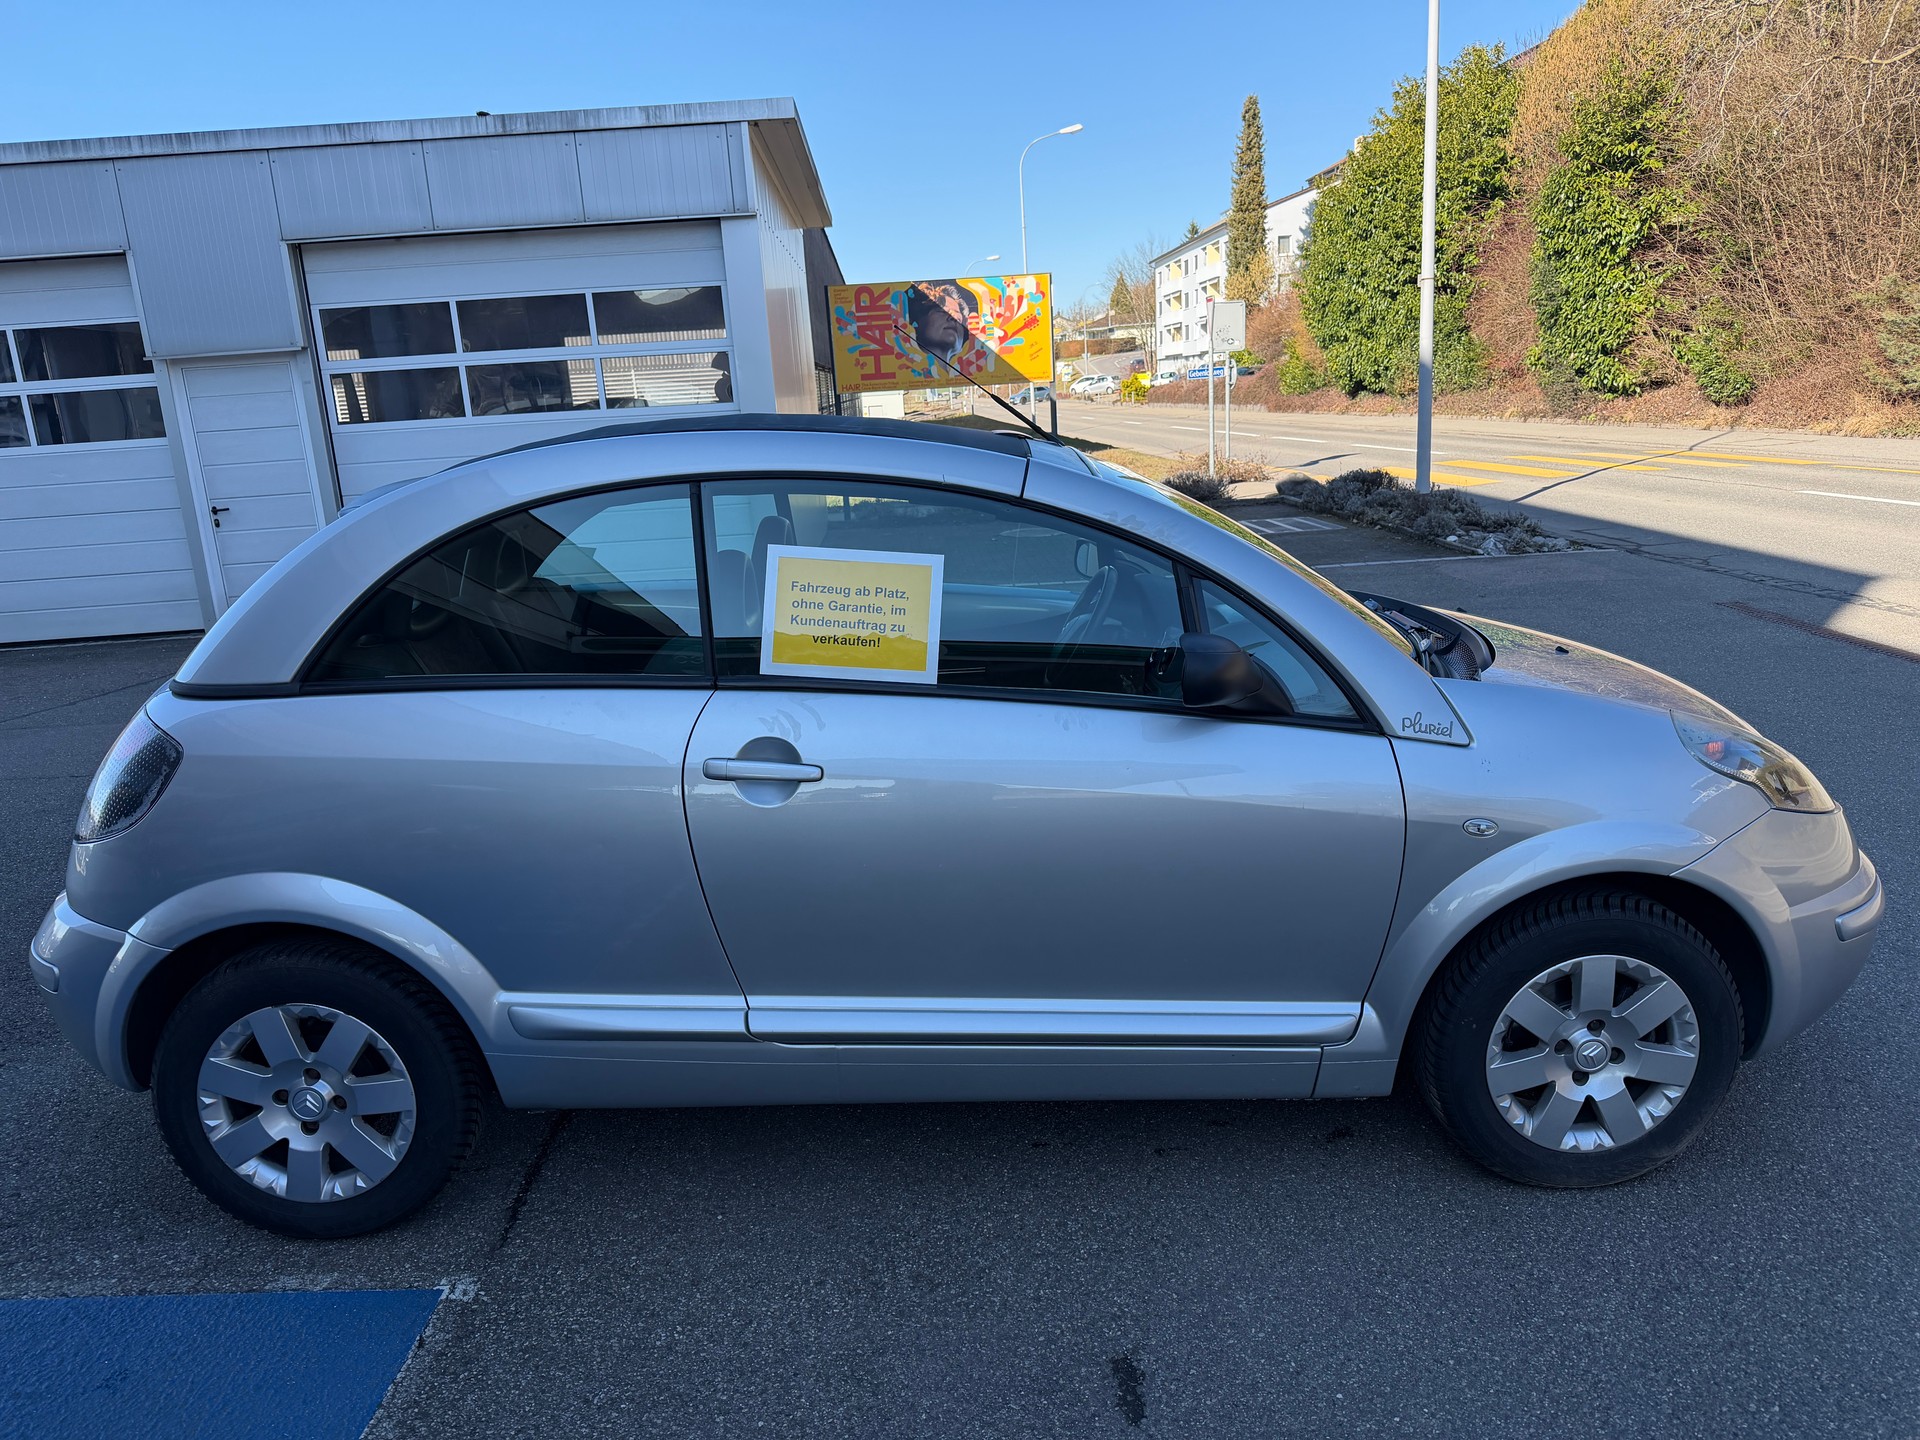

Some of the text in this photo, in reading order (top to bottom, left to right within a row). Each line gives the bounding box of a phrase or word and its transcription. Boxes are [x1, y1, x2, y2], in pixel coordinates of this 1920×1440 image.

[854, 286, 897, 381] HAIR
[841, 383, 860, 391] HAIR
[791, 581, 910, 601] Fahrzeug ab Platz,
[792, 598, 906, 616] ohne Garantie, im
[790, 614, 905, 633] Kundenauftrag zu
[812, 634, 881, 648] verkaufen!
